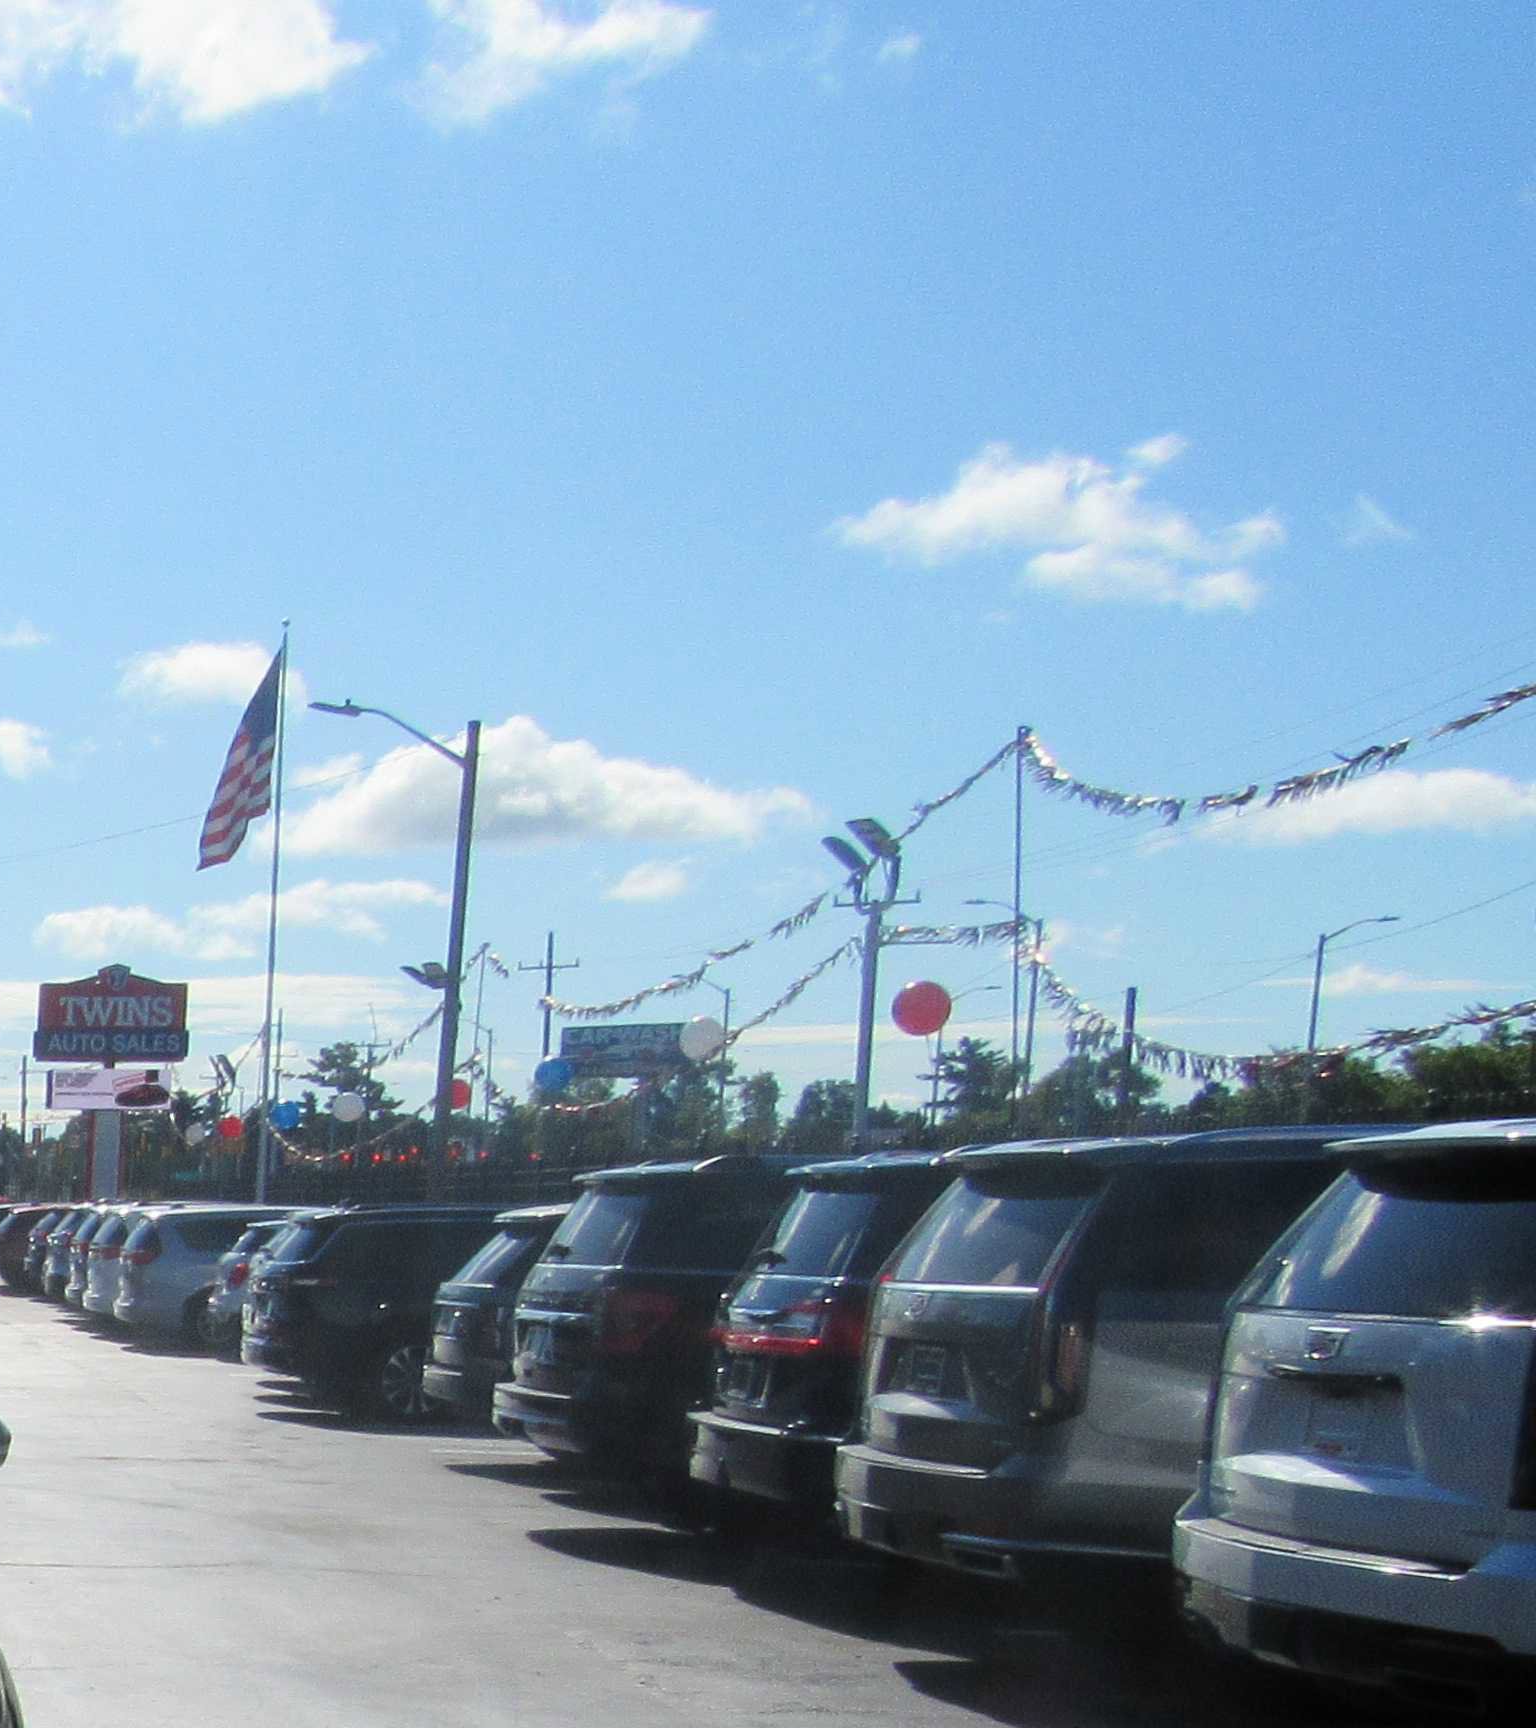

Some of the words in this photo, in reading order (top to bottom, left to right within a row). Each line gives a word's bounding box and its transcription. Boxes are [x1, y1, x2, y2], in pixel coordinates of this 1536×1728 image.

[58, 995, 175, 1027] TWINS
[48, 1033, 105, 1053] AUTO
[112, 1033, 179, 1053] SALES
